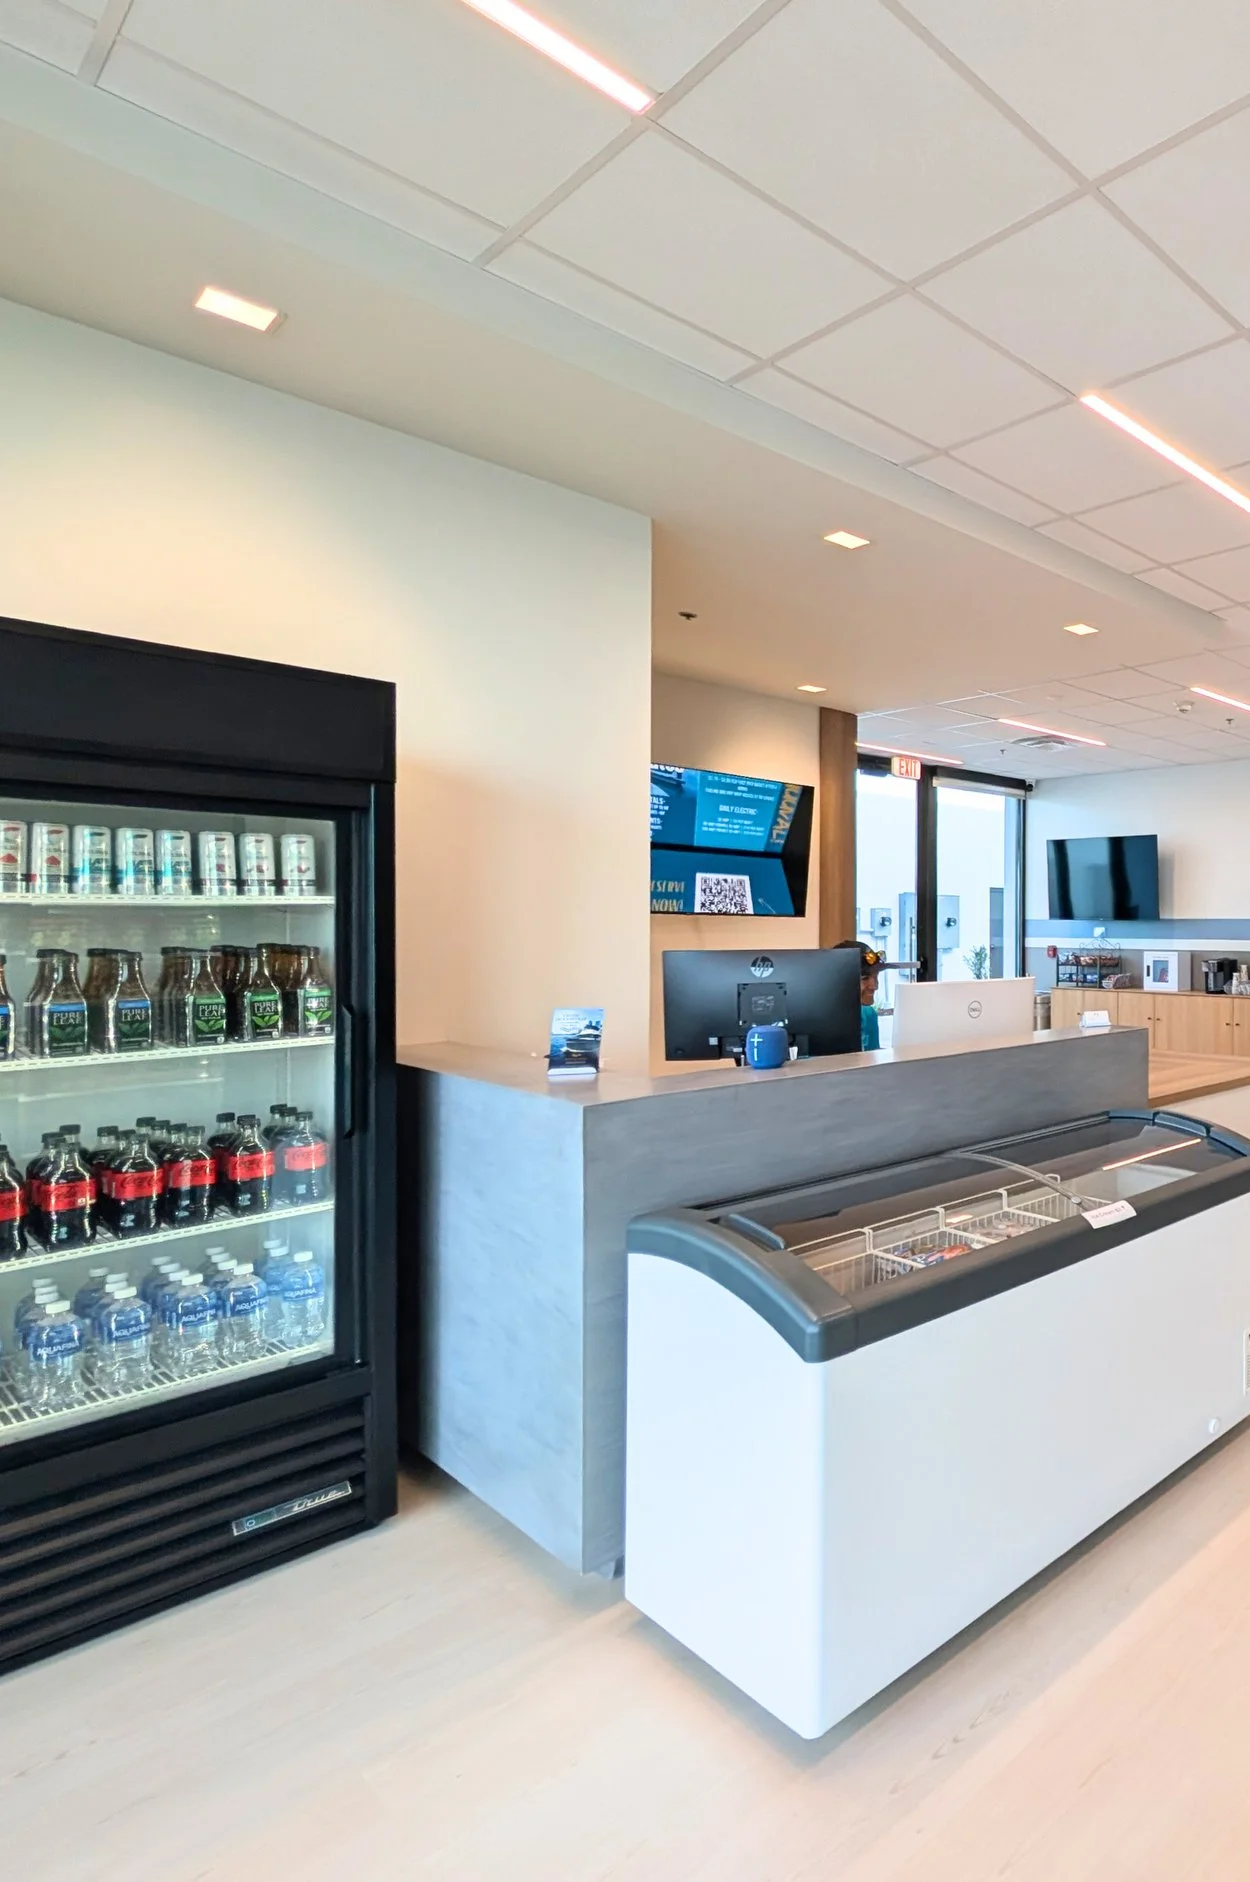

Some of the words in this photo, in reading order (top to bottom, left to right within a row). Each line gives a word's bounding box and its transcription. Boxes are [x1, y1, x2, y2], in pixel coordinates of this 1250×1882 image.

[899, 758, 918, 777] EXIT
[199, 1004, 224, 1012] PURE
[254, 1001, 276, 1009] PURE
[122, 1008, 147, 1016] PURE
[200, 1010, 223, 1018] LEAF
[255, 1007, 277, 1015] LEAF
[53, 1018, 81, 1026] LEAF
[122, 1014, 146, 1022] LEAF
